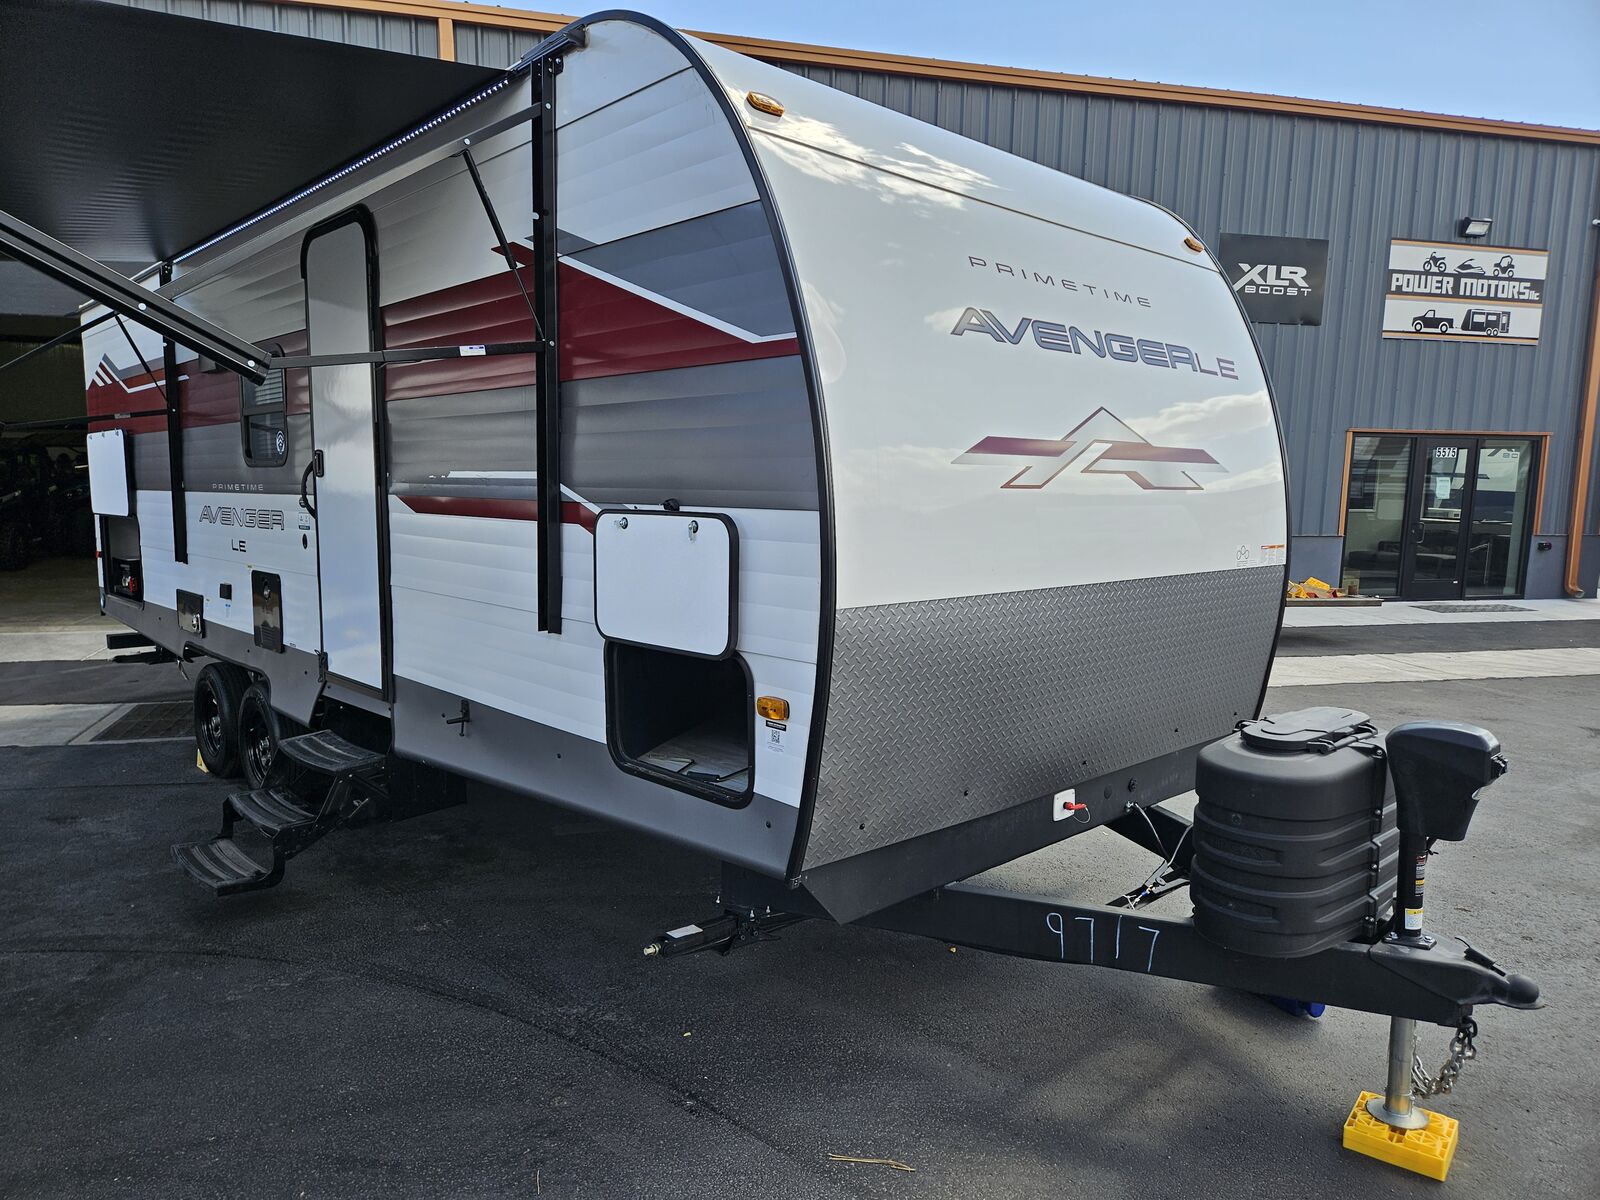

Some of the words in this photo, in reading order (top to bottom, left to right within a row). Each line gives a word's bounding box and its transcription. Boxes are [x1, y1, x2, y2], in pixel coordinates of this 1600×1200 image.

[968, 256, 1152, 308] PRIMETIME
[1232, 263, 1309, 292] XLR
[1390, 273, 1454, 295] POWER
[1459, 278, 1531, 300] MOTORS
[1244, 285, 1312, 297] BOOST
[950, 306, 1198, 373] AVENGER
[1194, 352, 1239, 381] LE
[1435, 447, 1458, 458] 5575
[211, 483, 264, 492] PRIMETIME
[198, 505, 285, 531] AVENGER
[231, 539, 247, 553] LE
[1046, 912, 1160, 972] 9717
